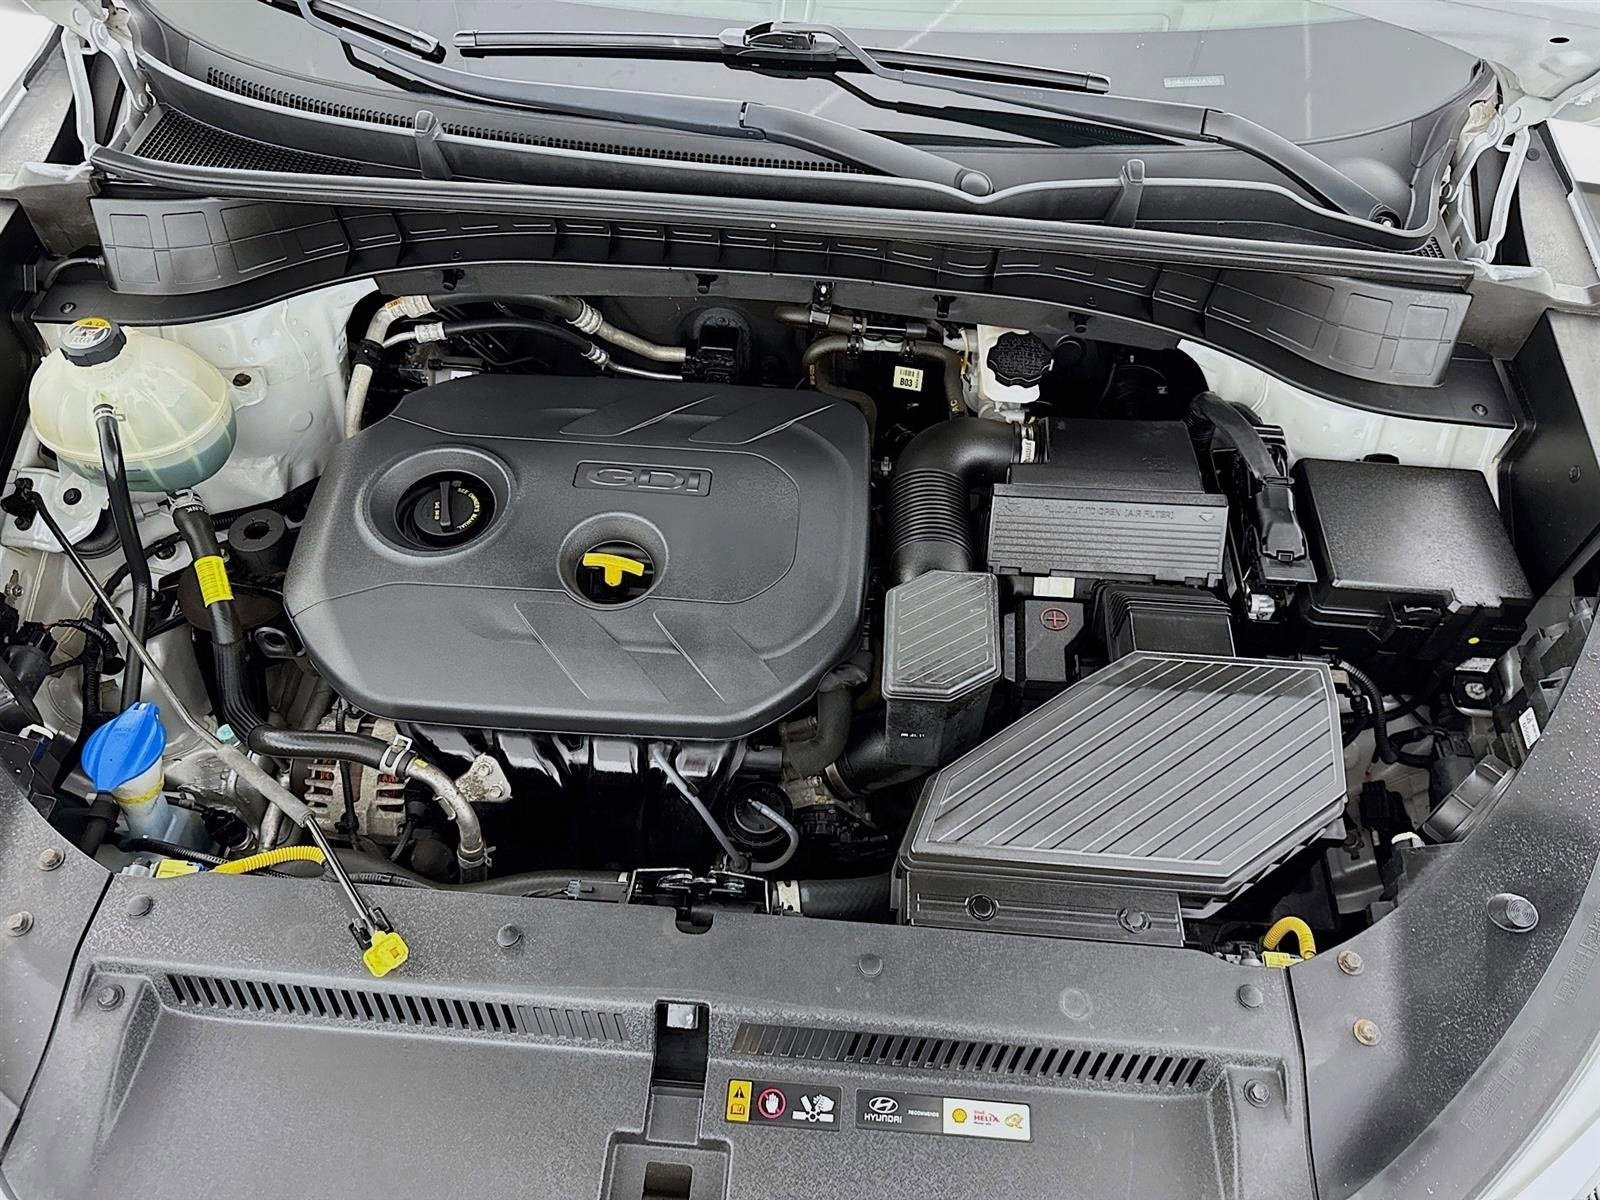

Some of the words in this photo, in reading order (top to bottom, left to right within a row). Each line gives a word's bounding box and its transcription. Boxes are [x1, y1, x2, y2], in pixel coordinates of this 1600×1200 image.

[900, 378, 912, 387] B03
[587, 467, 700, 492] GDI
[1099, 506, 1121, 517] OPEN
[864, 1112, 903, 1124] HYUNDAI
[908, 1110, 940, 1118] RECOMMENDS
[973, 1112, 1001, 1123] HELIX
